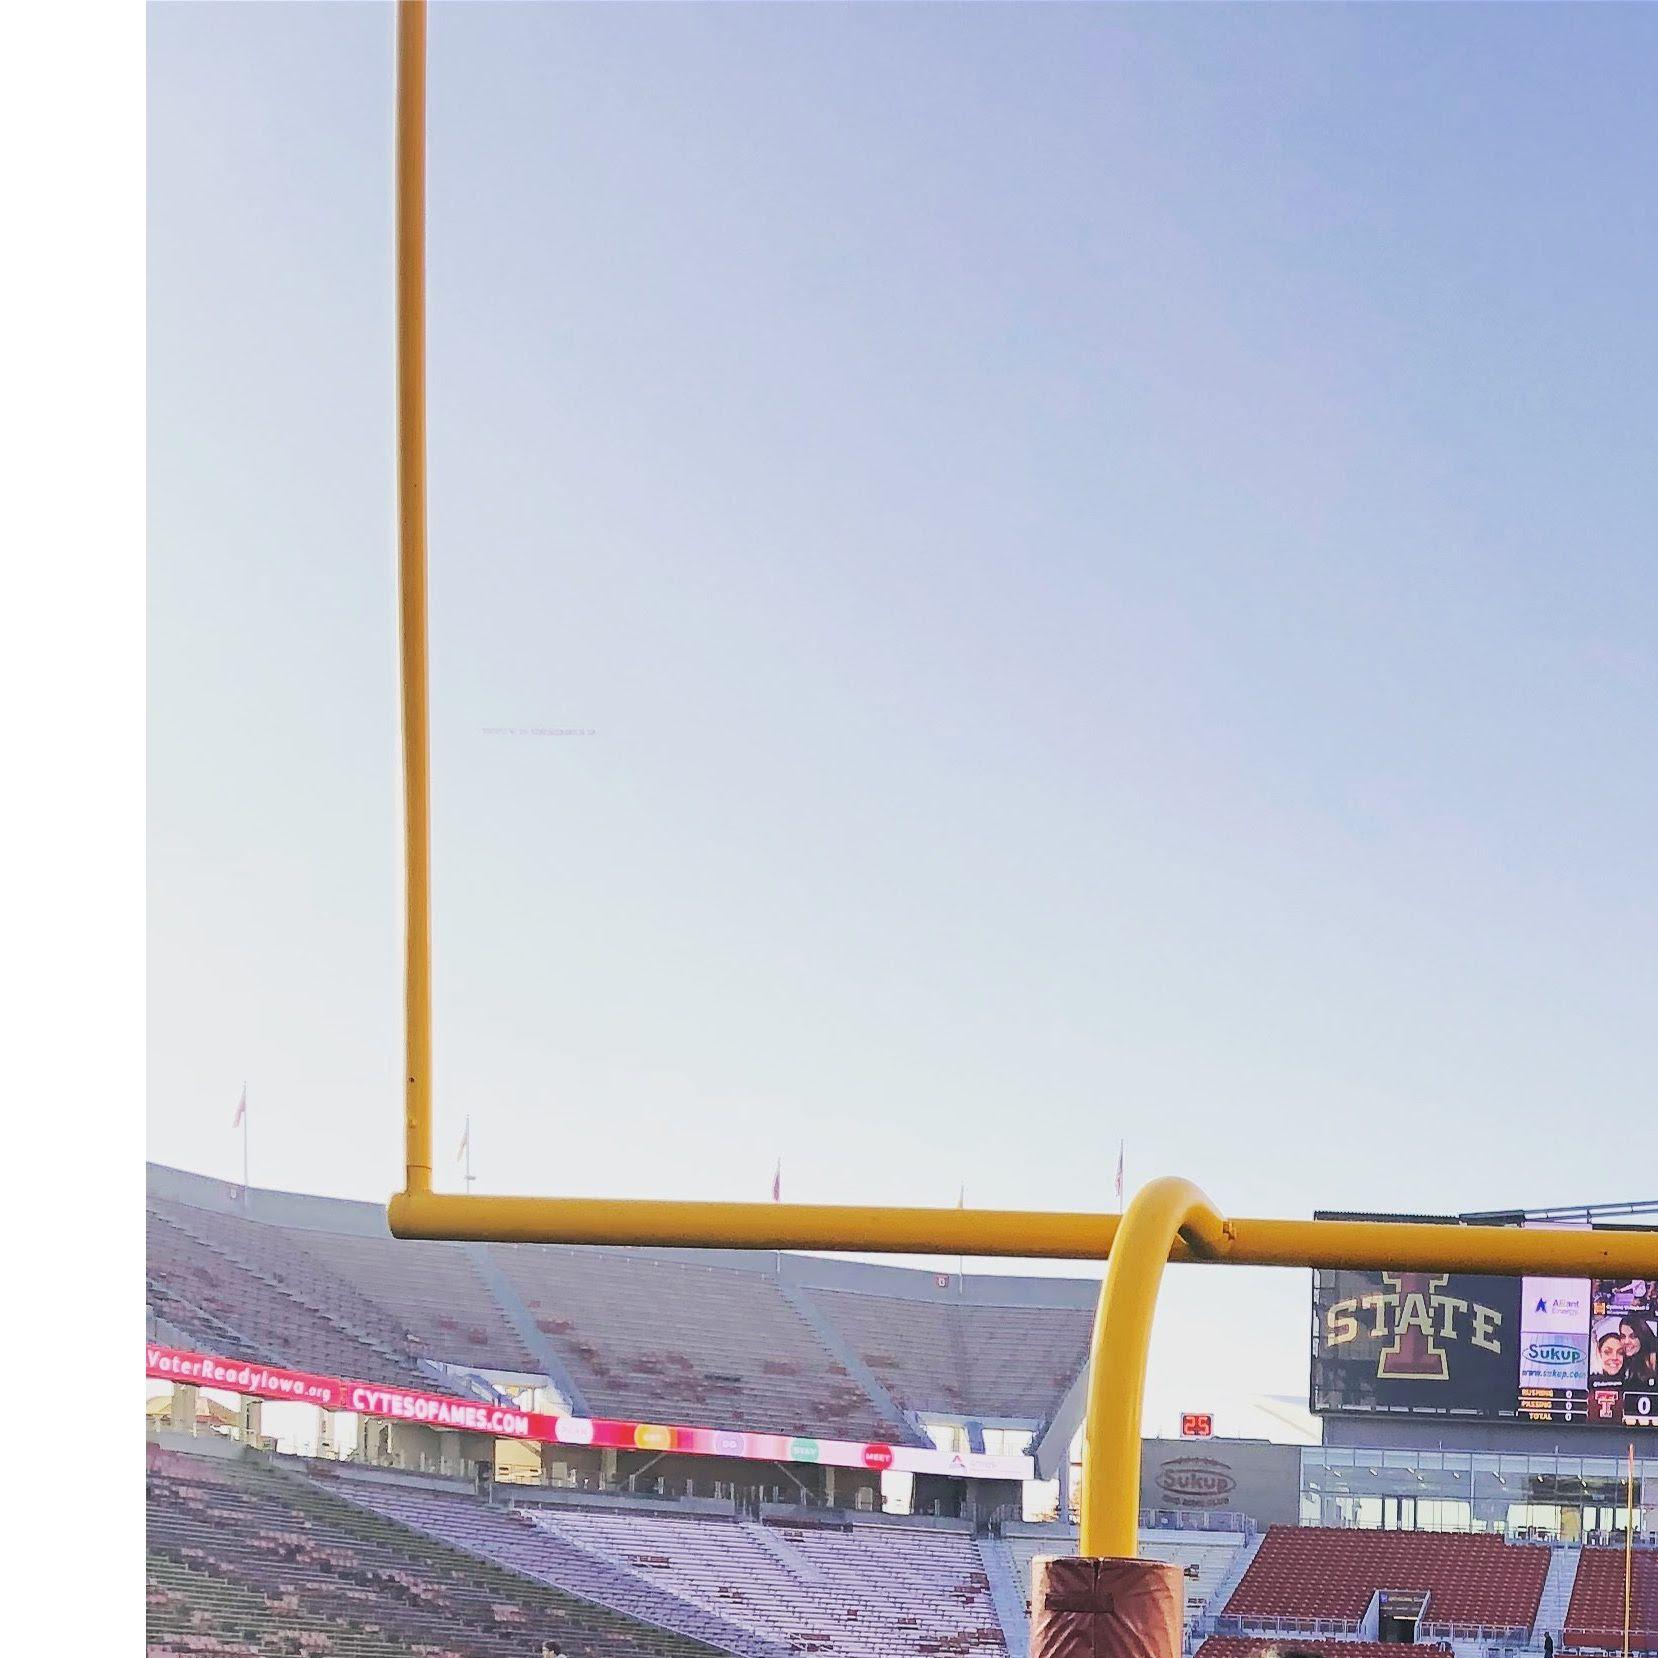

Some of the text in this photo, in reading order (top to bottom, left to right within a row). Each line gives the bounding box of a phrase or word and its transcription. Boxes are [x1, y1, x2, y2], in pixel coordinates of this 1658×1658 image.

[1327, 1293, 1502, 1354] STATE
[1528, 1344, 1581, 1363] Sukup
[353, 1388, 528, 1435] CYTESOFAMES.COM
[1637, 1396, 1651, 1414] 0
[1185, 1416, 1210, 1435] 25
[1164, 1469, 1228, 1493] Sukup
